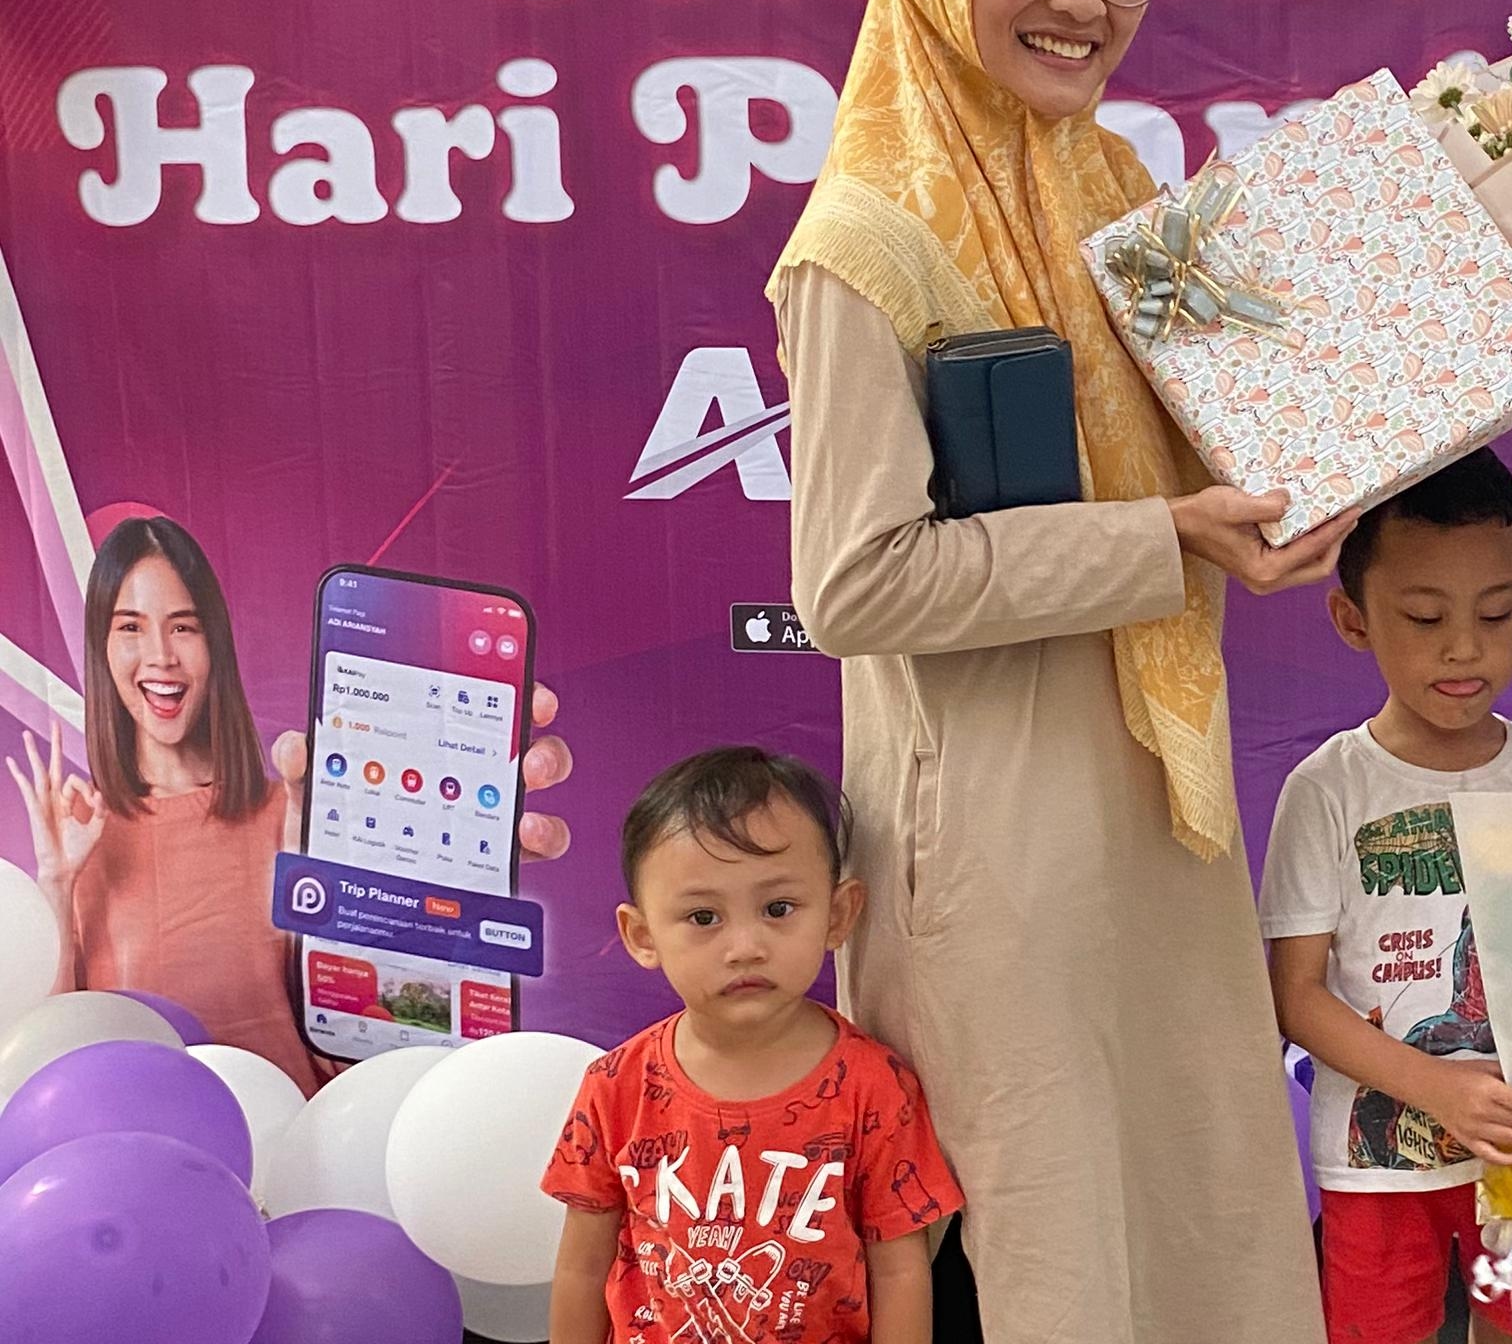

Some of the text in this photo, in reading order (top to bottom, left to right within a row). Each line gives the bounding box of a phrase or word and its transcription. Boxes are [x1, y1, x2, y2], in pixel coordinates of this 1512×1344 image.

[55, 57, 576, 226] Hari
[332, 683, 390, 702] Rp1.000.000
[349, 721, 370, 732] 1.000
[438, 739, 486, 755] Lihat Detail
[1360, 848, 1466, 896] SPIDE
[338, 880, 420, 909] Trip Planner
[484, 927, 526, 943] BUTTON
[1377, 929, 1435, 953] CRISIS
[1395, 951, 1414, 962] ON
[1371, 957, 1443, 984] CAMPUS!
[687, 1224, 745, 1257] YEAH!
